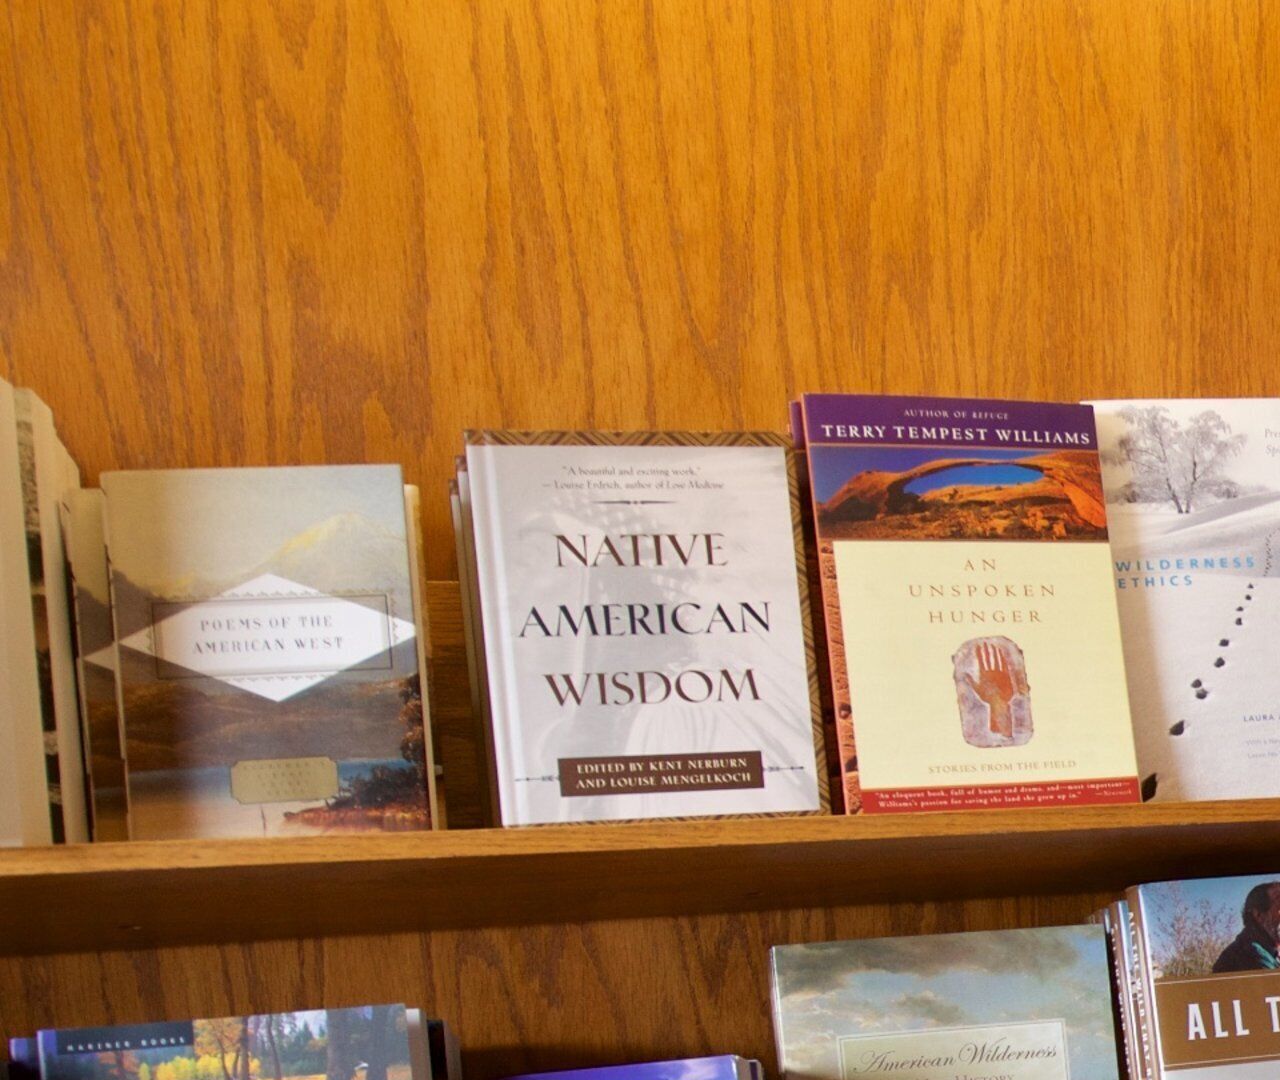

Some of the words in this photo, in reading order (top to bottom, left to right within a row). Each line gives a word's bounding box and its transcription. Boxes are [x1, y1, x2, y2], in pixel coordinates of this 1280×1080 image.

[821, 425, 886, 438] TERRY
[893, 426, 988, 441] TEMPEST
[996, 429, 1091, 444] WILLIAMS
[554, 533, 728, 567] NATIVE
[964, 559, 996, 571] AN
[1115, 556, 1255, 572] WILDERNESS
[1118, 575, 1193, 589] ETHICS
[908, 584, 1056, 597] UNSPOKEN
[201, 617, 261, 632] POEMS
[269, 617, 291, 628] OF
[298, 615, 333, 627] THE
[519, 602, 771, 637] AMERICAN
[929, 610, 1042, 623] HUNGER
[193, 639, 285, 655] AMERICAN
[295, 637, 343, 650] WEST
[544, 669, 762, 706] WISDOM
[577, 764, 625, 774] EDITED
[629, 763, 644, 772] BY
[650, 761, 682, 770] KENT
[688, 759, 747, 769] NERBURN
[928, 763, 977, 774] STORIES
[980, 762, 1012, 772] FROM
[1016, 761, 1037, 770] THE
[1043, 759, 1076, 769] FIELD
[576, 779, 606, 789] AND
[610, 776, 656, 787] LOUISE
[660, 773, 751, 785] MENGELKOCH
[1187, 999, 1250, 1041] ALL
